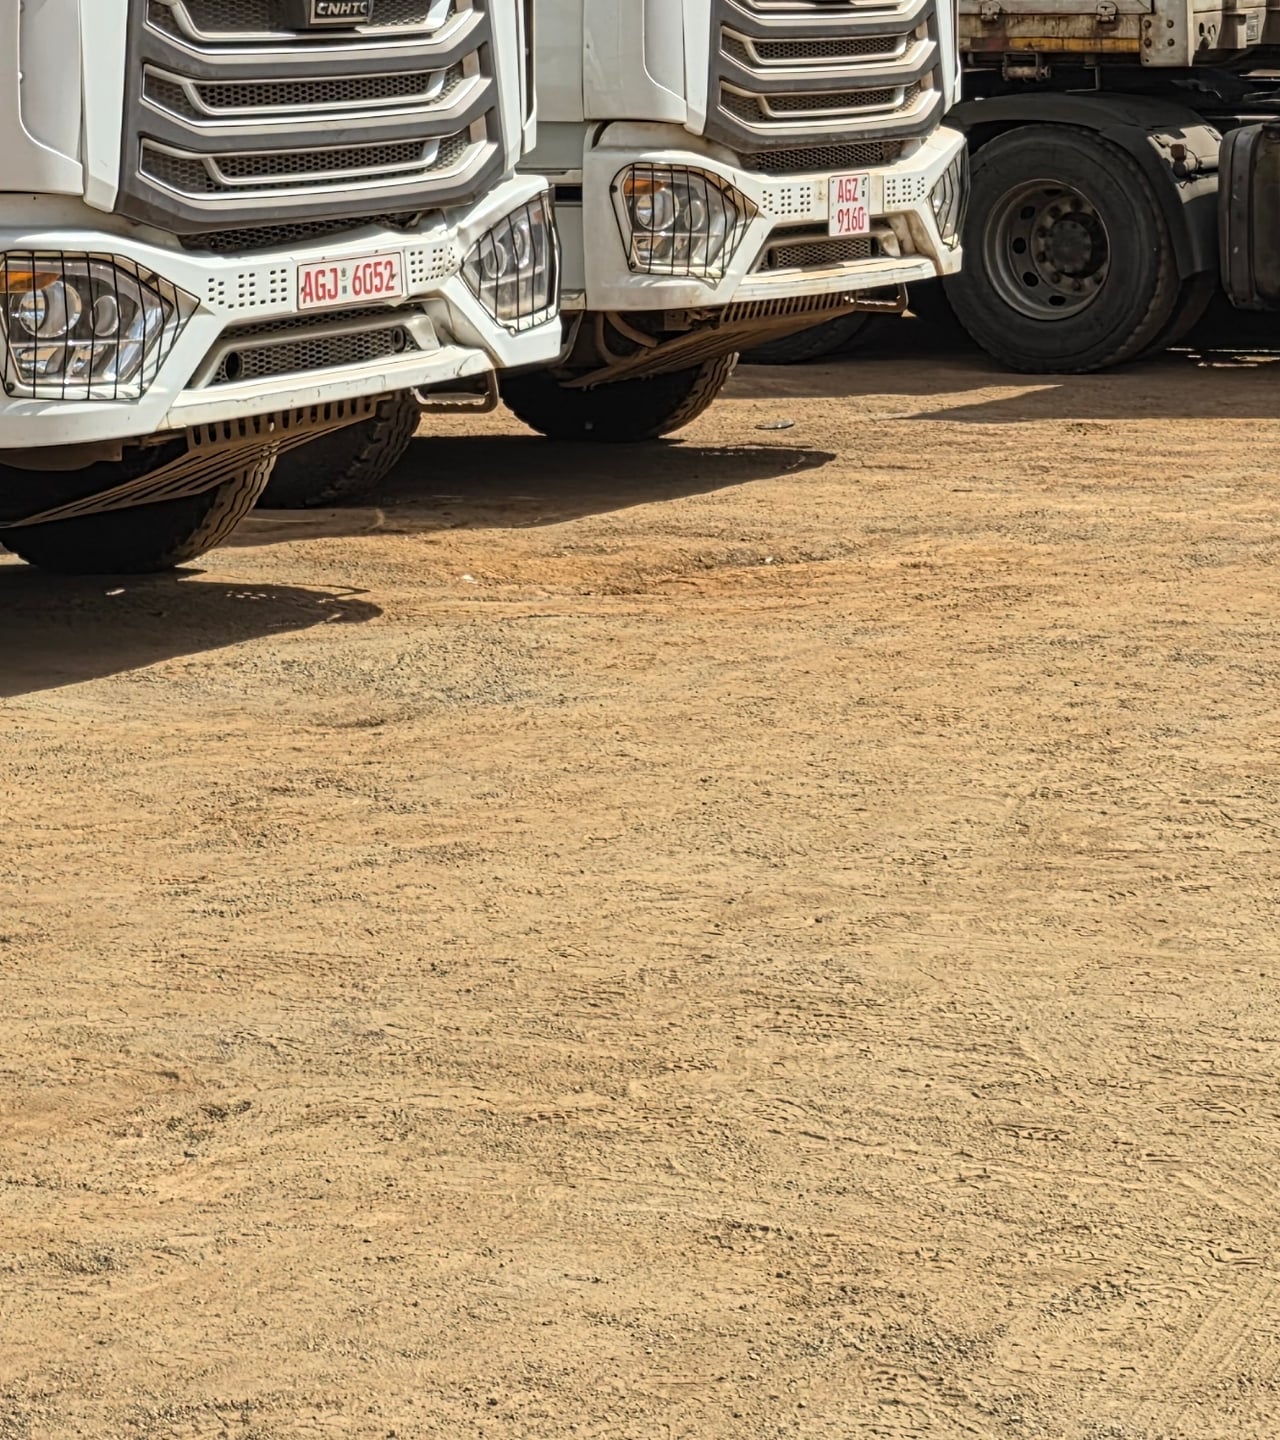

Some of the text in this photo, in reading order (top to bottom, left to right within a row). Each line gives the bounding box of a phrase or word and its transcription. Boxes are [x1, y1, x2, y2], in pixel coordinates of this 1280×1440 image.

[317, 1, 368, 15] CNHTC
[837, 178, 859, 204] AGZ
[837, 206, 865, 233] 9160
[302, 260, 396, 304] AGJ 6052
